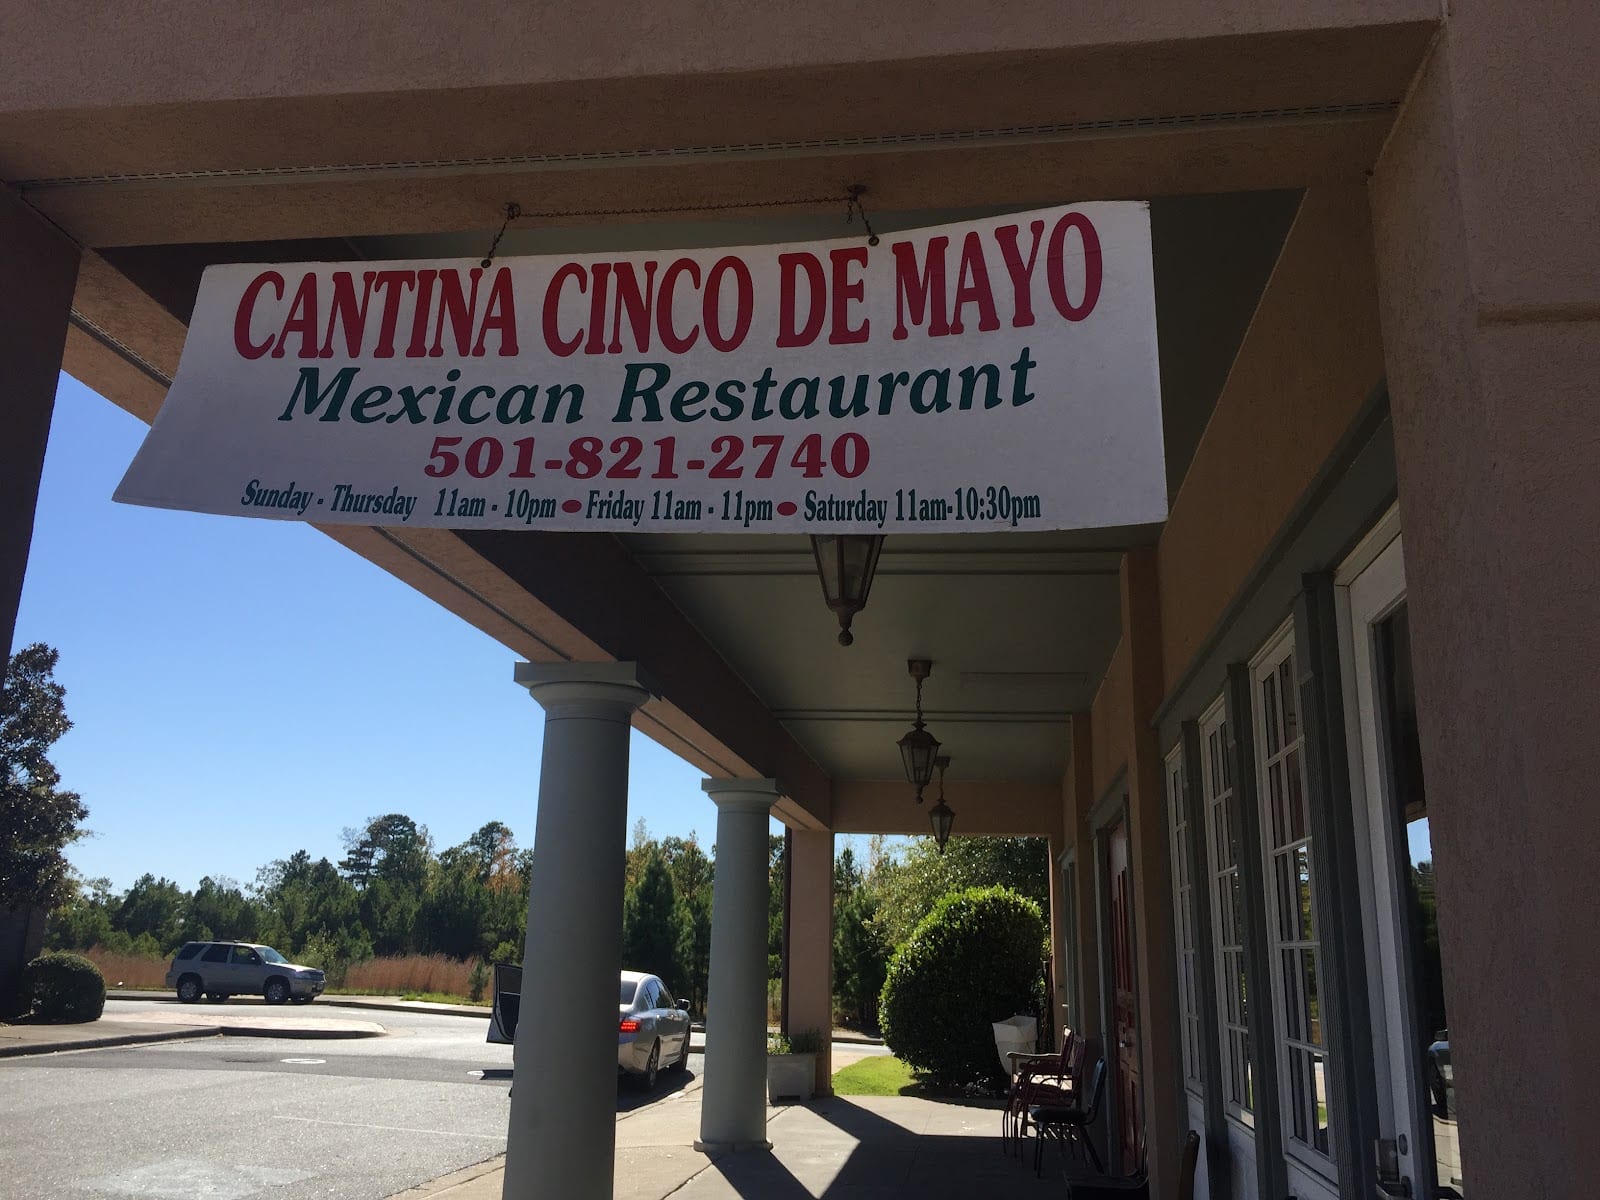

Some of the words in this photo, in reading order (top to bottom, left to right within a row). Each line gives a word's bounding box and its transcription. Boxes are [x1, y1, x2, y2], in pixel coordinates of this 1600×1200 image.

[233, 266, 519, 360] CANTINA
[542, 255, 754, 357] CINCO
[776, 246, 870, 349] DE
[892, 212, 1103, 341] MAYO
[278, 367, 585, 425] Mexican
[611, 346, 1037, 423] Restaurant
[424, 432, 870, 479] 501-821-2740
[241, 479, 313, 516] Sunday
[331, 484, 418, 521] Thursday
[434, 488, 486, 517] 11am
[504, 488, 556, 524] 10pm
[585, 489, 645, 526] Friday
[651, 490, 702, 520] 11am
[721, 490, 773, 528] 11pm
[804, 489, 887, 528] Saturday
[895, 486, 1041, 526] 11am-10:30pm
